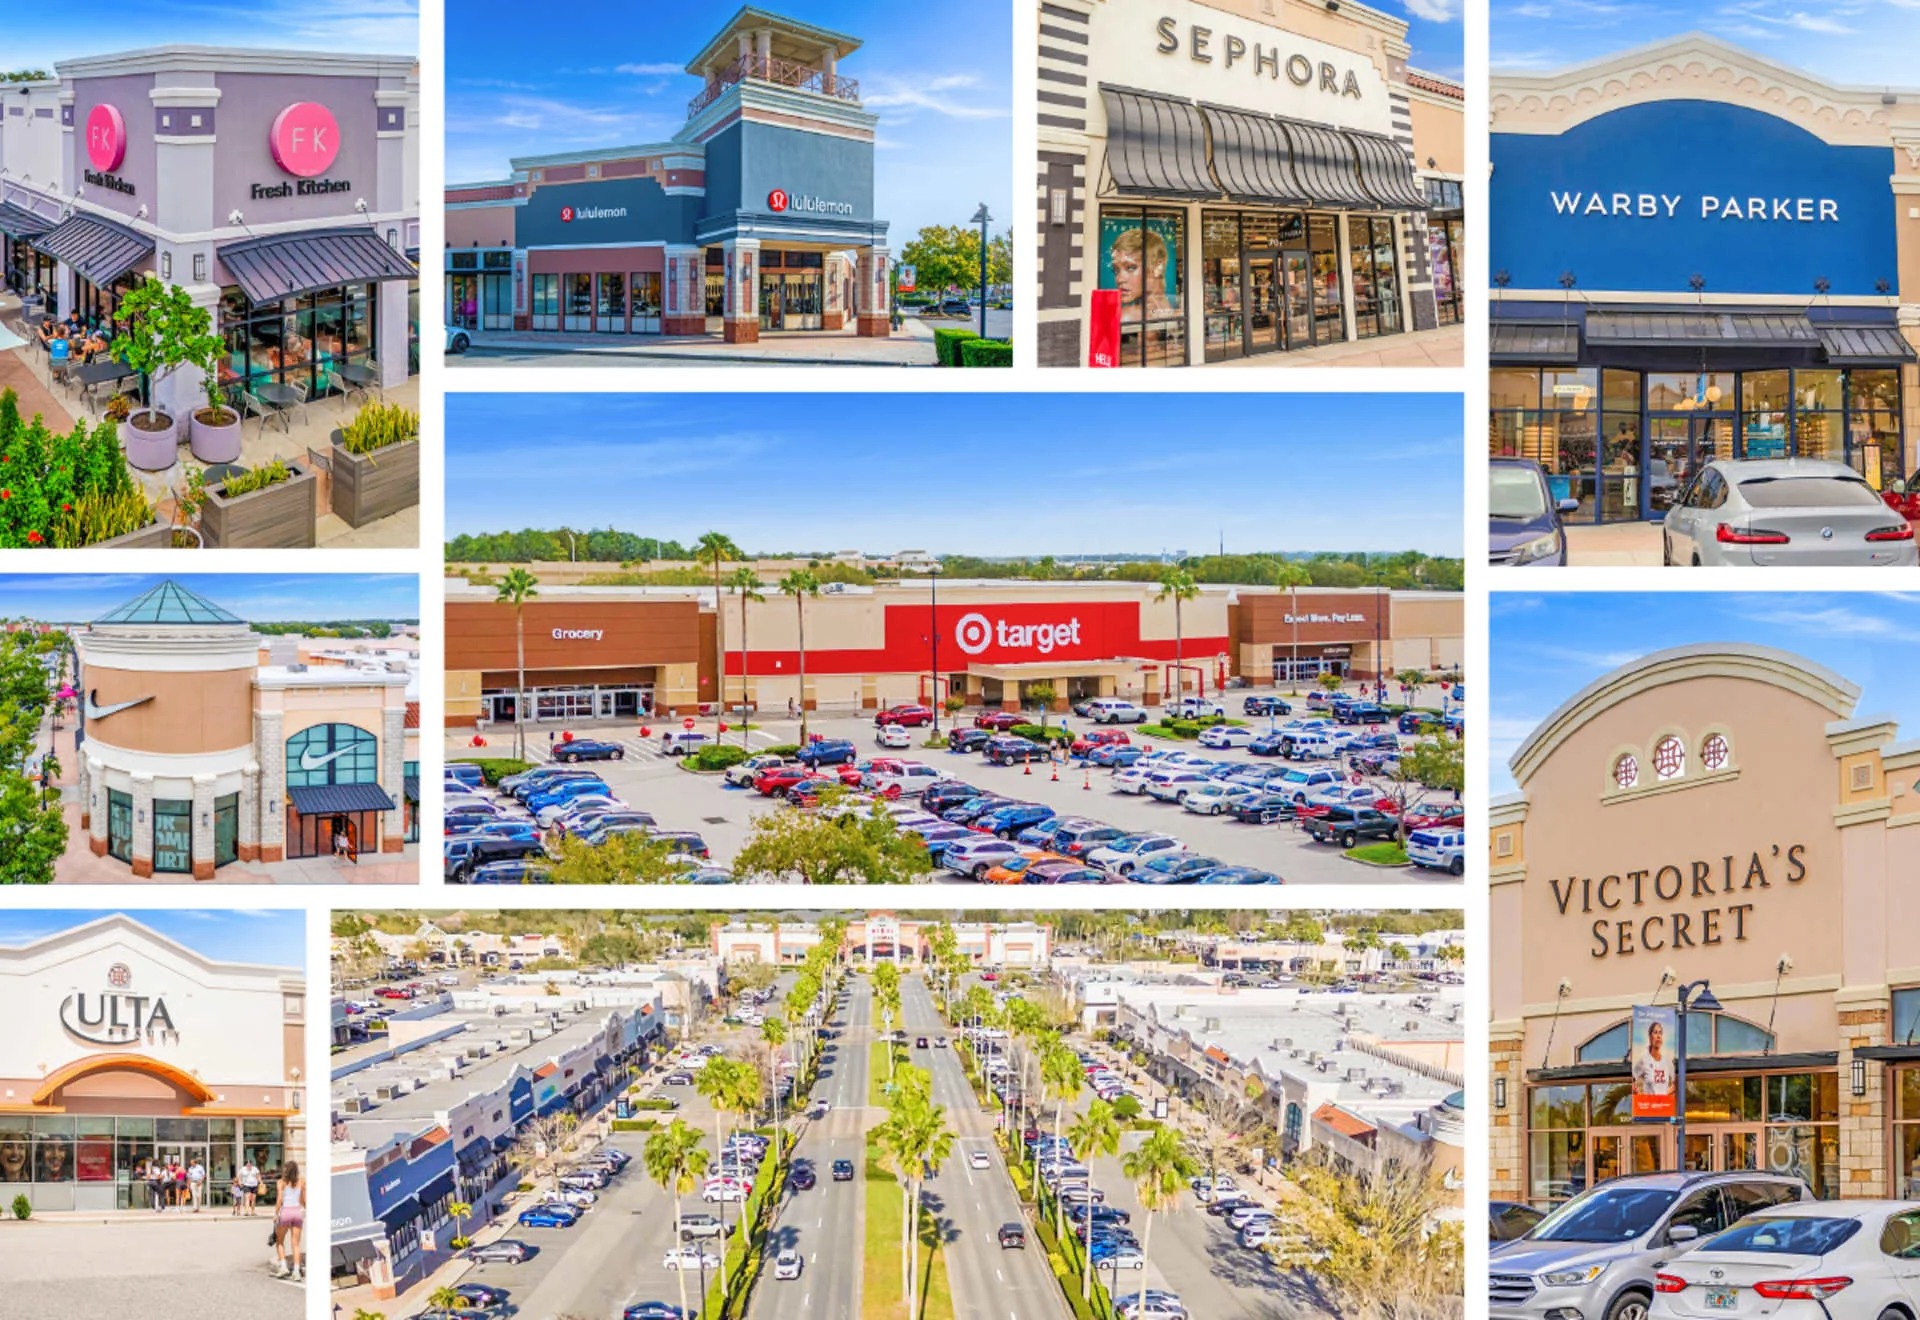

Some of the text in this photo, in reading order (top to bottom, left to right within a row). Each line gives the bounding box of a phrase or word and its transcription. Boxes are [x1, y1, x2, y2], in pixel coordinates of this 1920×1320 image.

[1156, 16, 1363, 100] SEPHORA
[250, 178, 351, 200] Fresh Kitchen
[791, 192, 853, 216] lululemon
[576, 207, 628, 220] lululemon
[1550, 191, 1840, 222] WARBY PARKER
[552, 628, 604, 641] Grocery
[996, 617, 1081, 654] target
[1548, 844, 1806, 916] VICTORIA'S
[1591, 904, 1753, 958] SECRET
[78, 992, 176, 1031] ULTA
